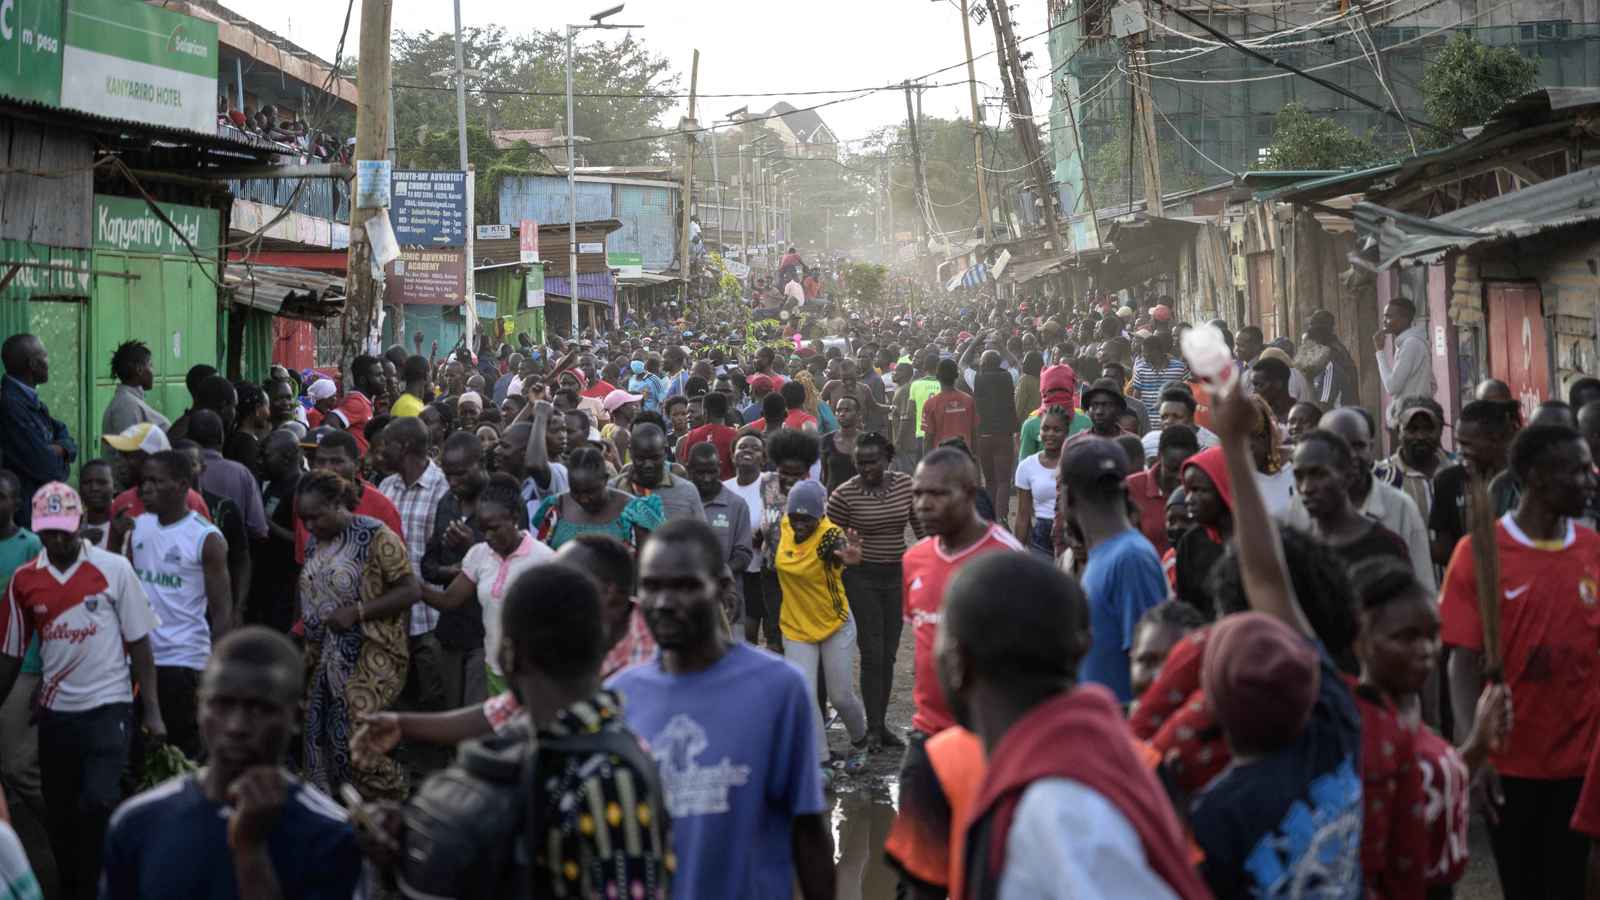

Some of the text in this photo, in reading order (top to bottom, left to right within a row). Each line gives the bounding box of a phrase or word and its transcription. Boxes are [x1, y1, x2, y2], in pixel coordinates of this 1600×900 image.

[175, 36, 208, 57] Safaricom
[106, 75, 183, 108] KANYARIRO HOTEL
[430, 172, 464, 182] ADVENTIST
[99, 204, 162, 250] Kanyariro
[421, 253, 459, 262] ADVENTIST
[408, 262, 440, 271] ACADEMY
